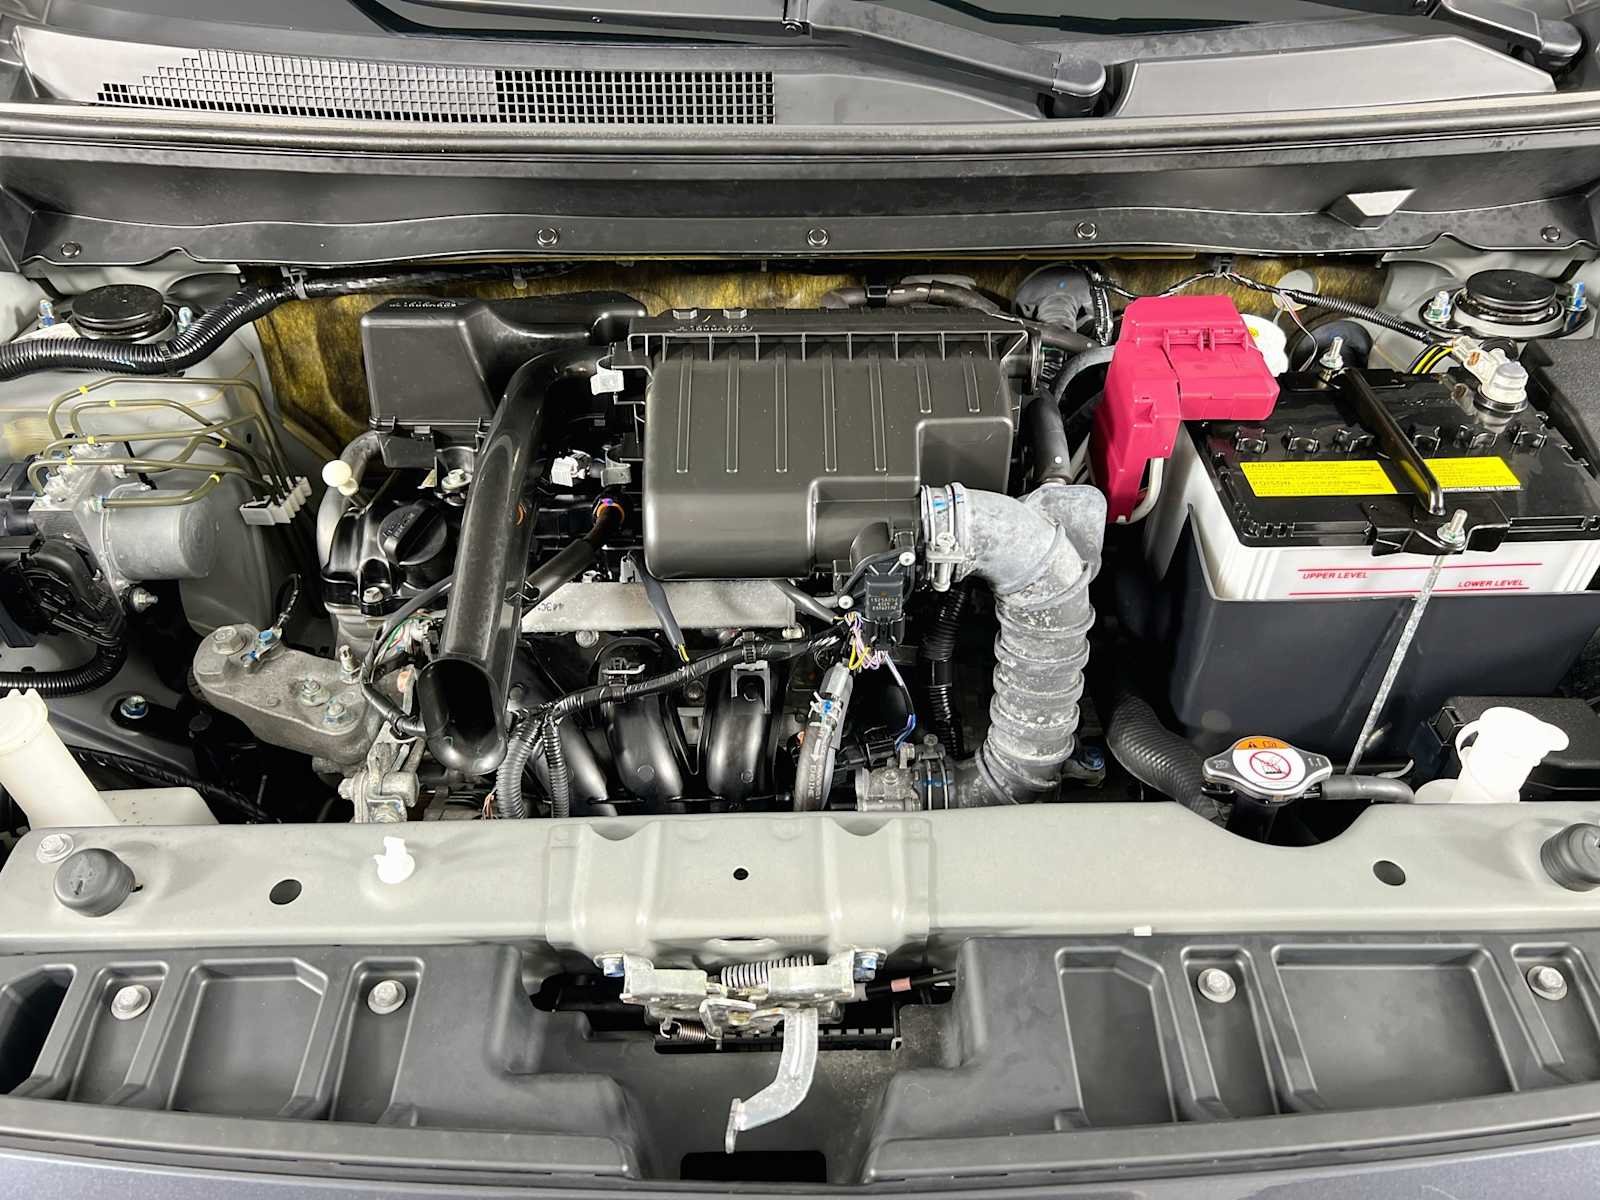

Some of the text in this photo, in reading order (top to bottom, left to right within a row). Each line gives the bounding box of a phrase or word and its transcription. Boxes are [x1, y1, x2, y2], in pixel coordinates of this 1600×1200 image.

[1302, 571, 1369, 580] UPPER LEVEL
[1457, 579, 1524, 588] LOWER LEVEL
